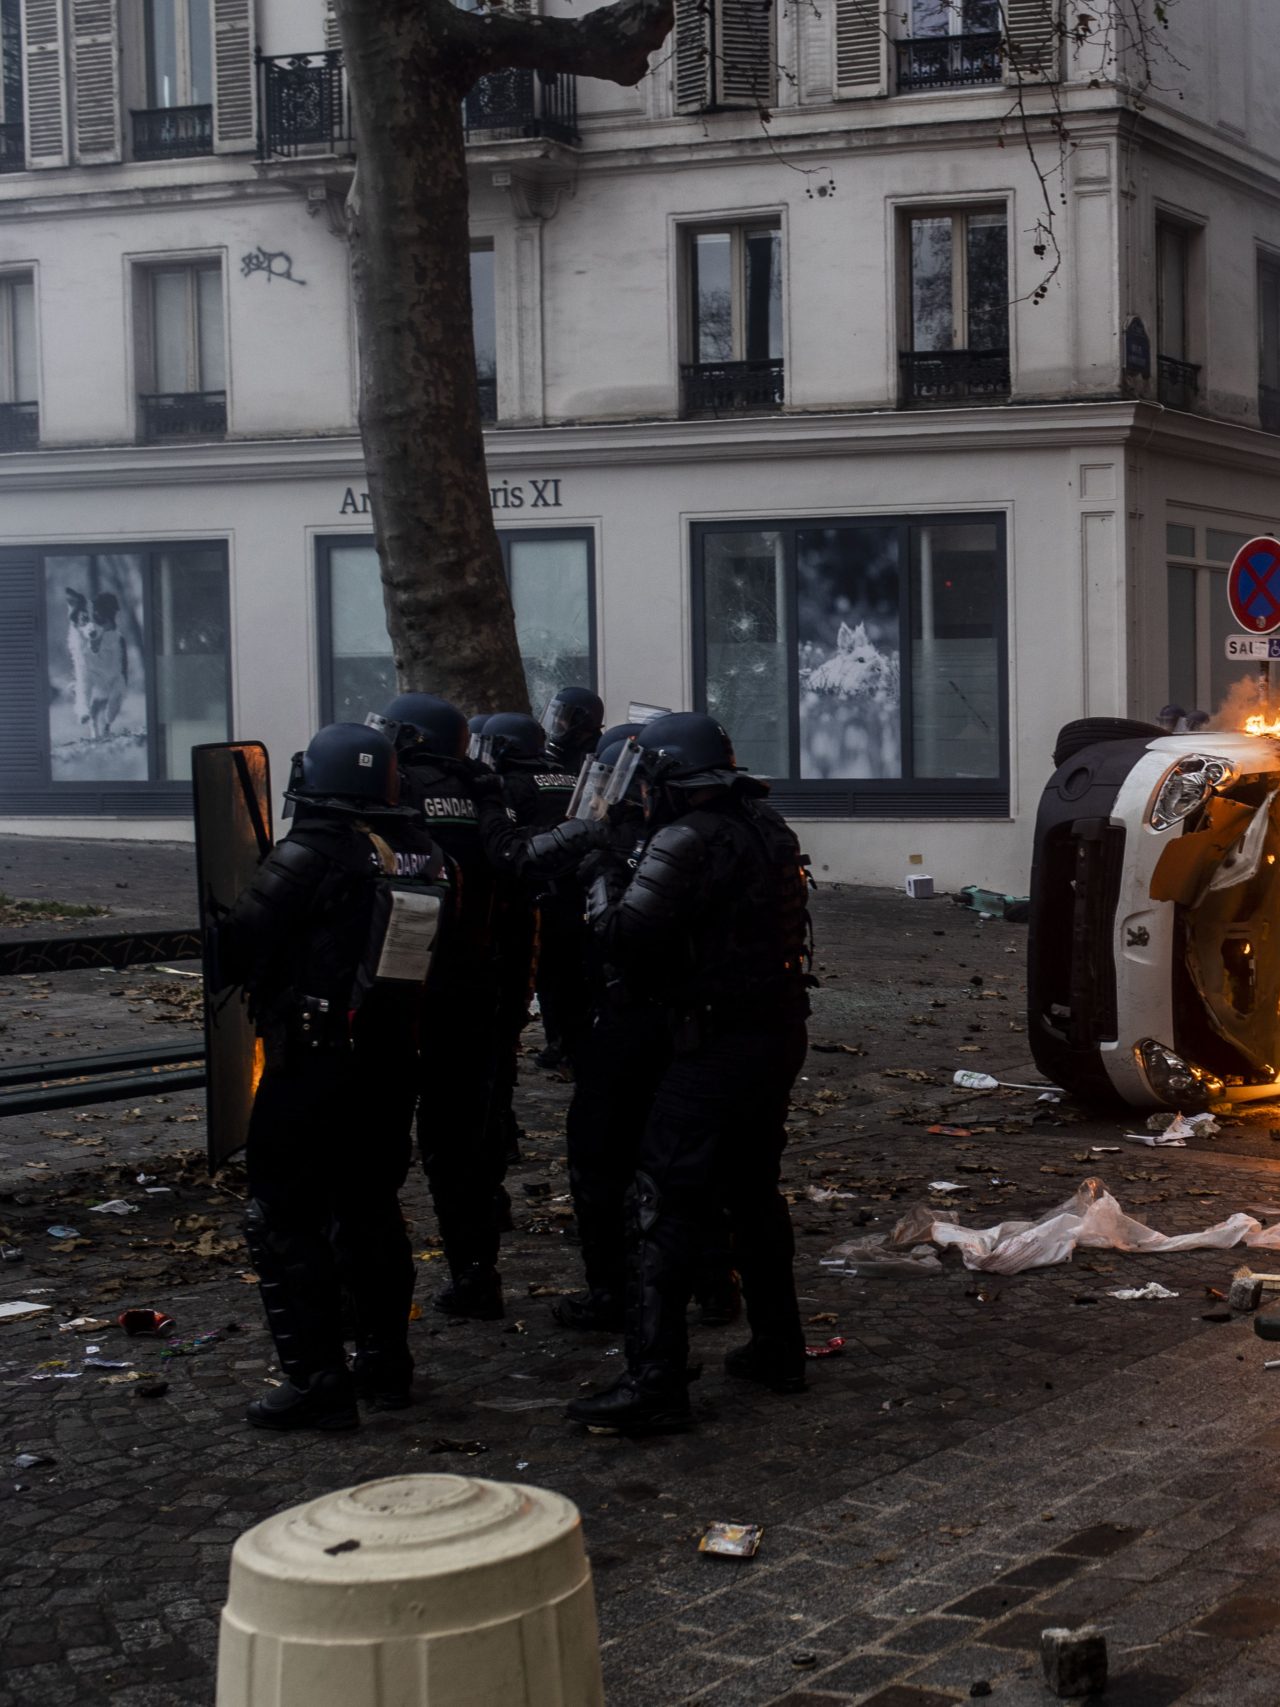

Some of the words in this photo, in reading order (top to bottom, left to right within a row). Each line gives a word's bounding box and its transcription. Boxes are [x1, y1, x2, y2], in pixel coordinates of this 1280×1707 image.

[489, 479, 524, 508] ris
[529, 478, 563, 507] XI
[1229, 641, 1267, 655] SA
